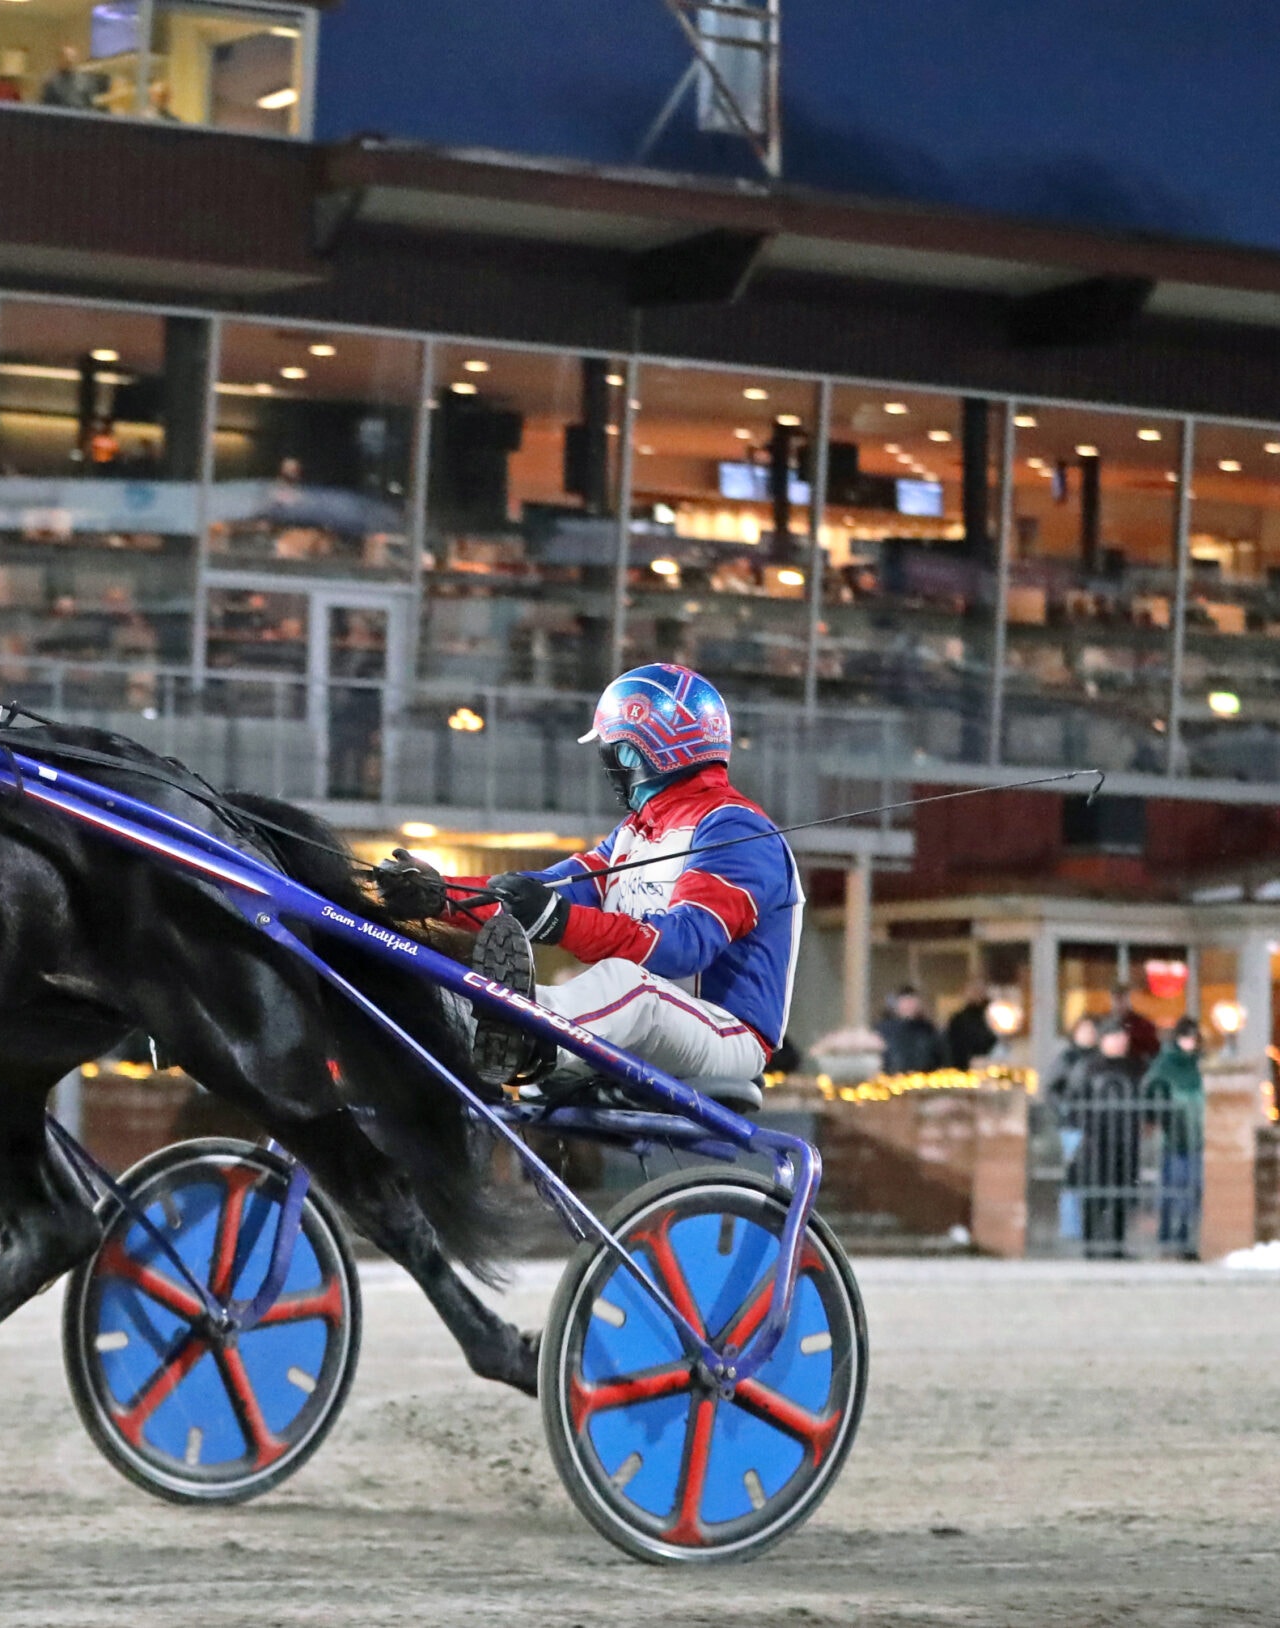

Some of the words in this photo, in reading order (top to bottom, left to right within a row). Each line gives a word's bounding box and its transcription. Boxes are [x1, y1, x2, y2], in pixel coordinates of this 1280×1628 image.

[630, 705, 641, 718] K
[321, 905, 356, 928] Team
[358, 922, 419, 956] Midtfjeld
